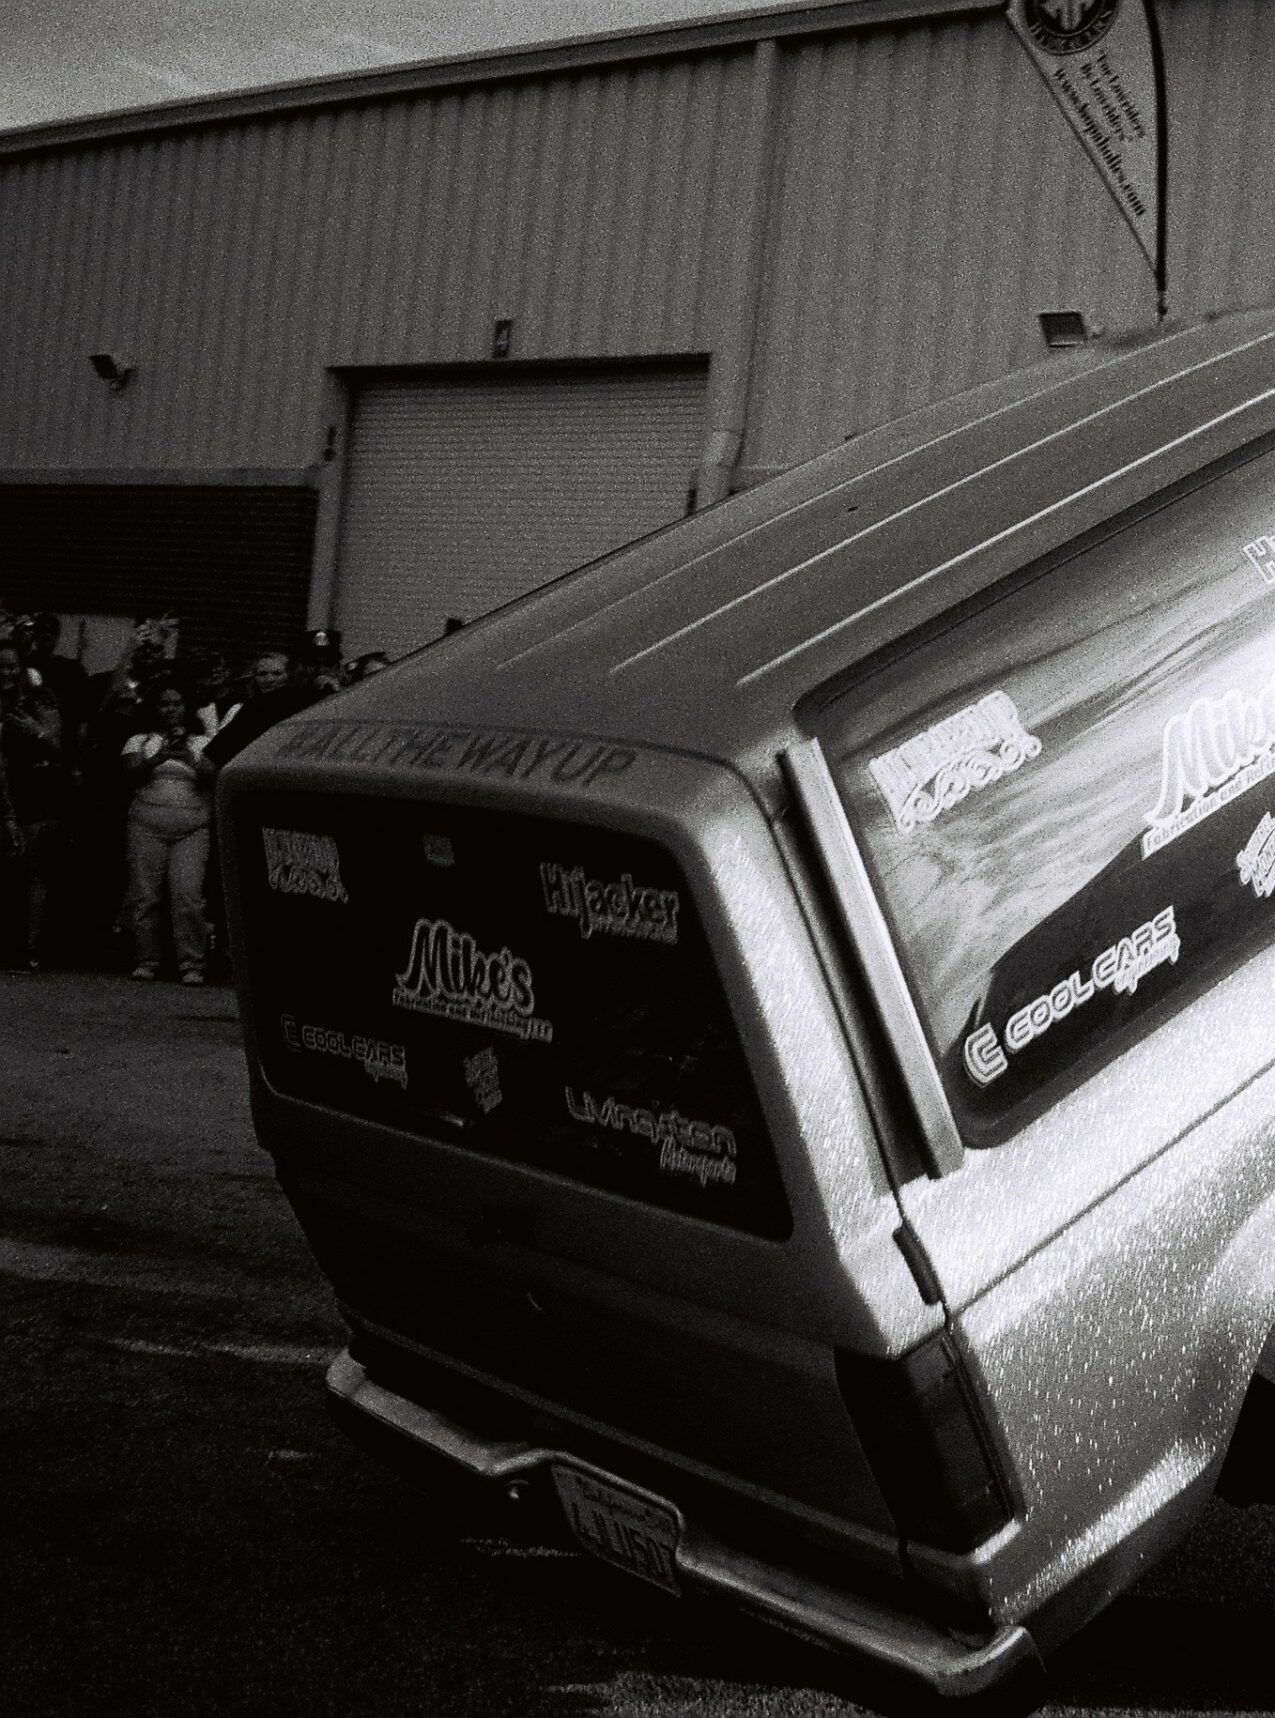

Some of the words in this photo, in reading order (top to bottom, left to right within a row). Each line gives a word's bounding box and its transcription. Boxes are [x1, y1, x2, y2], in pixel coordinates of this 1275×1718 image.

[1139, 794, 1219, 853] Fabrication
[1216, 776, 1245, 801] and
[540, 862, 680, 939] Hijacker
[396, 919, 535, 1014] Mike's
[564, 1086, 740, 1158] Livingston
